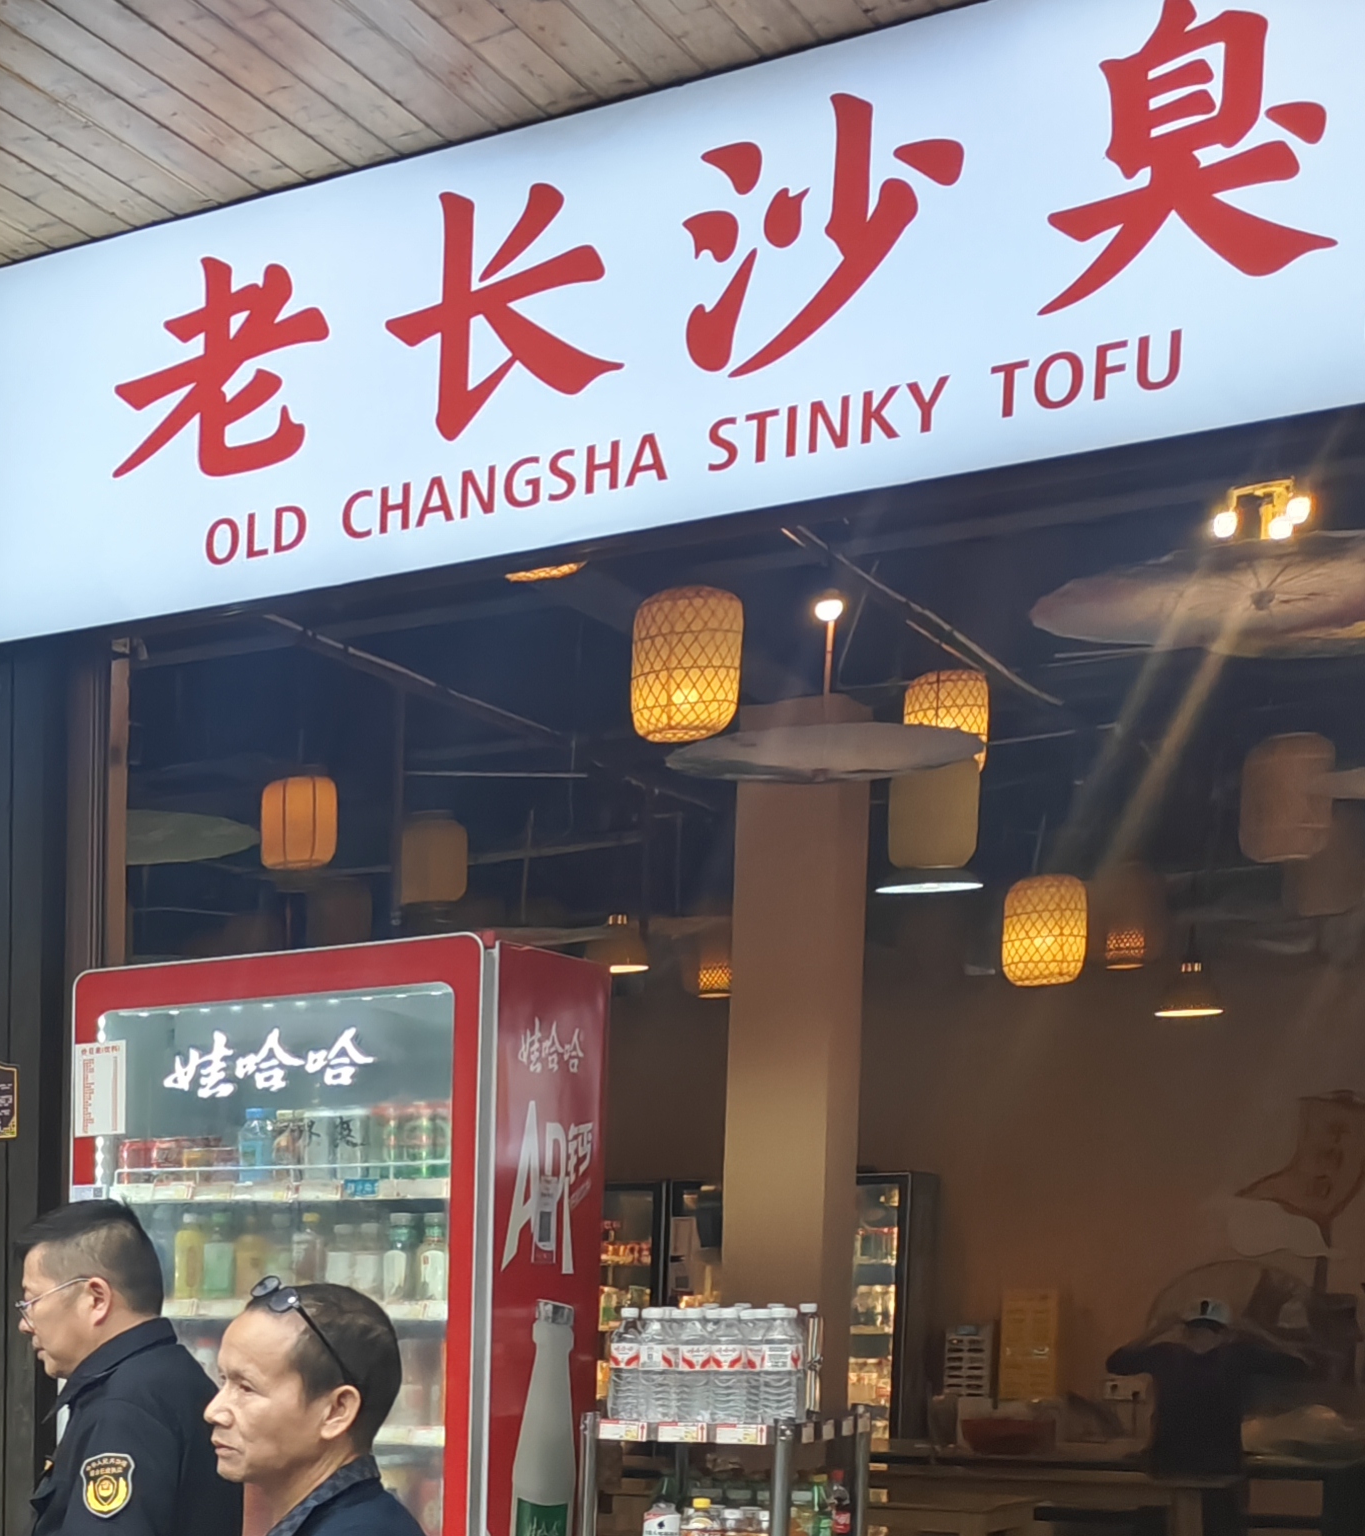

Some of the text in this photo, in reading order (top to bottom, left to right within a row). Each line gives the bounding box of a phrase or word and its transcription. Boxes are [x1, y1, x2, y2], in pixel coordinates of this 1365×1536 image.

[113, 0, 1338, 480] 老长沙臭
[205, 328, 1184, 567] OLD CHANGSHA STINKY TOFU
[163, 1026, 375, 1098] 娃哈哈
[518, 1017, 584, 1074] 娃哈哈
